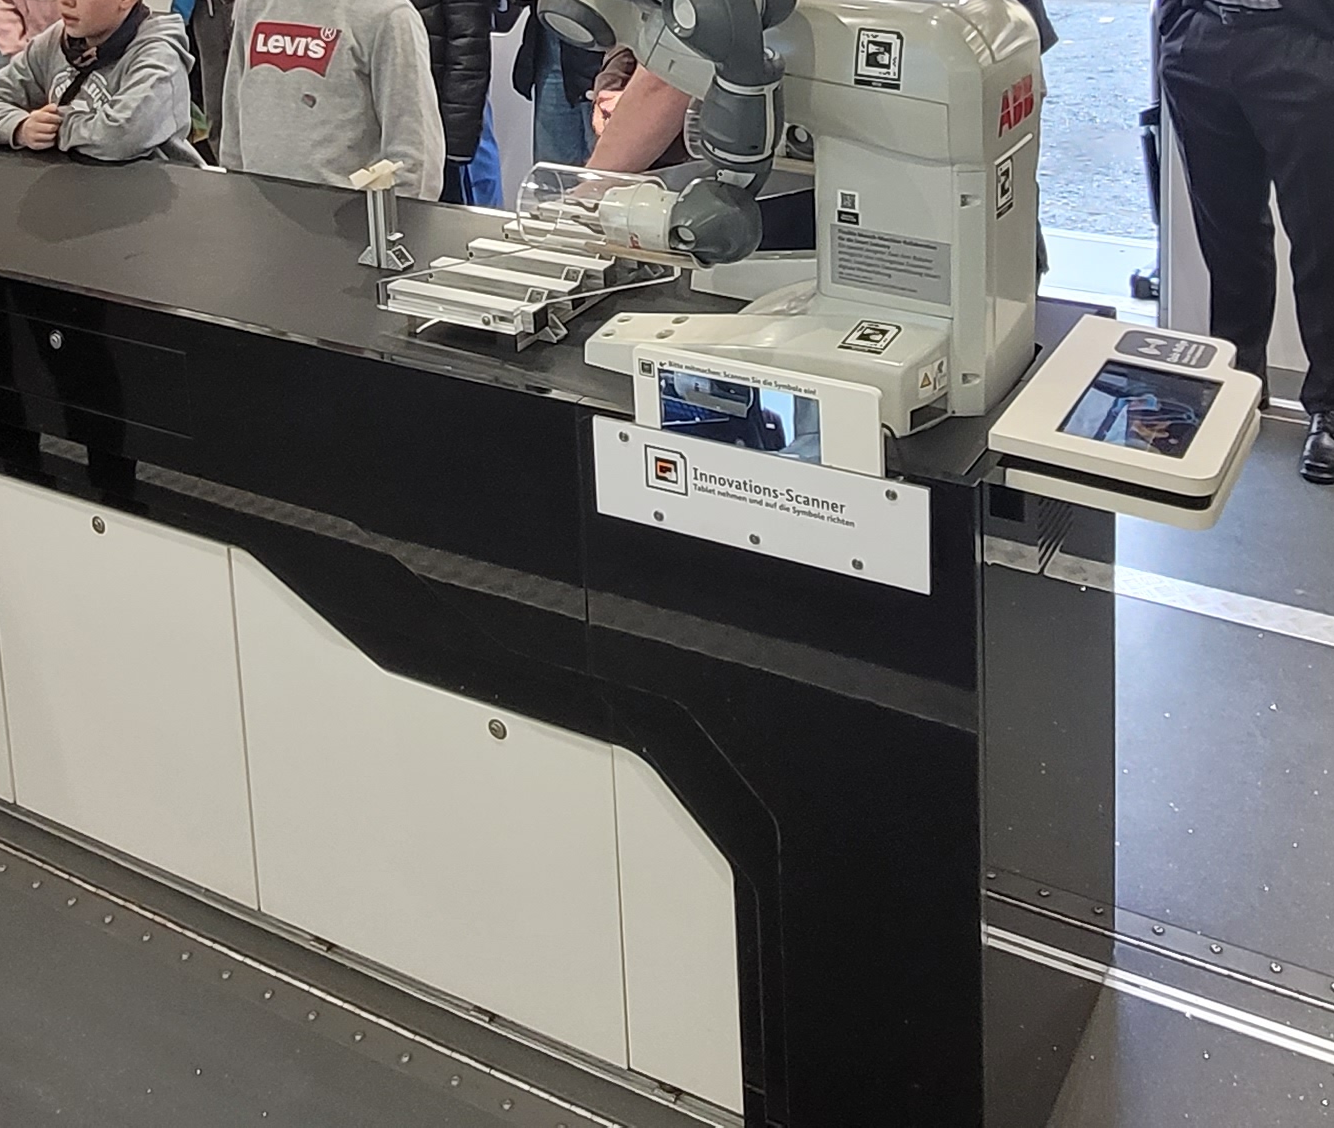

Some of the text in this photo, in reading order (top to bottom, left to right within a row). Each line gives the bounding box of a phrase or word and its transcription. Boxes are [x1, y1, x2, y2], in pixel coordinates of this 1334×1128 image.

[998, 74, 1034, 139] ABB
[751, 376, 761, 385] Sie
[762, 378, 773, 387] die
[773, 380, 803, 393] Symbole
[692, 466, 847, 515] Innovations-Scanner
[693, 483, 856, 528] Tablet nehmen und auf die Symbole richten
